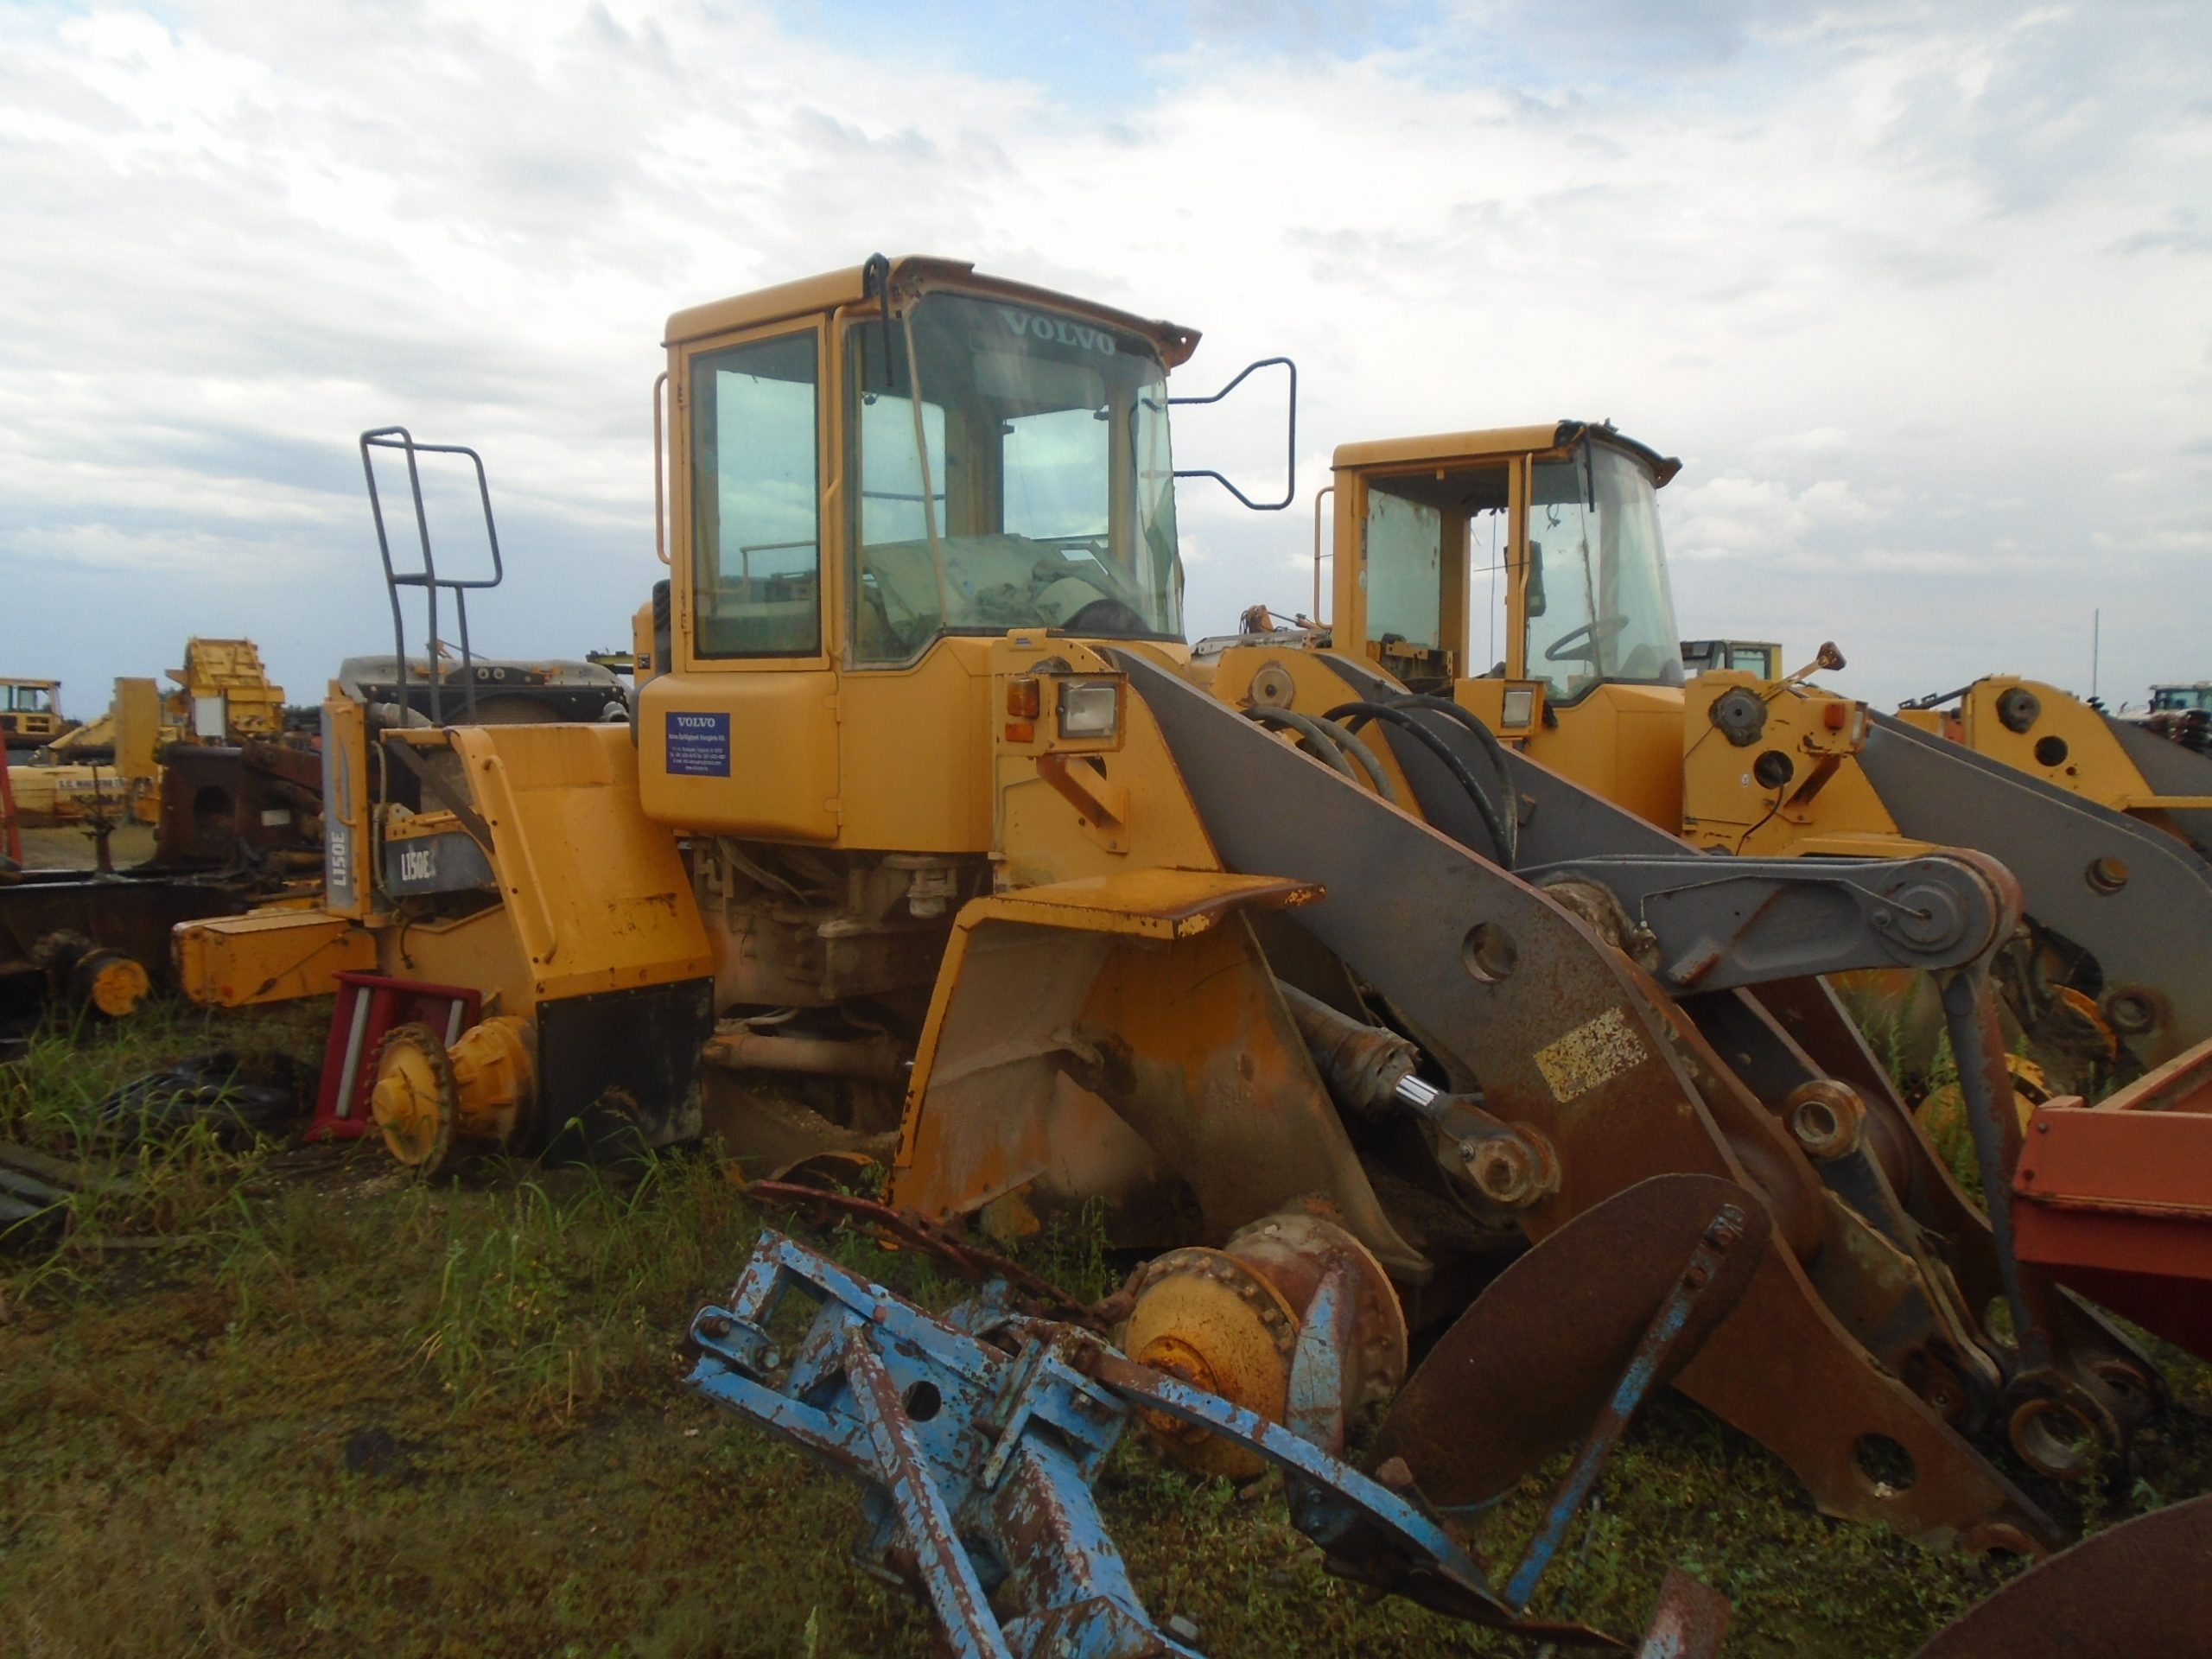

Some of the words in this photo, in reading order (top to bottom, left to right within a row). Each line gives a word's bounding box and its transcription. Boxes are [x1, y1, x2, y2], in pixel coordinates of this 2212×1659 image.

[998, 308, 1117, 356] VOLVO
[677, 716, 716, 728] VOLVO
[331, 831, 346, 887] L150E
